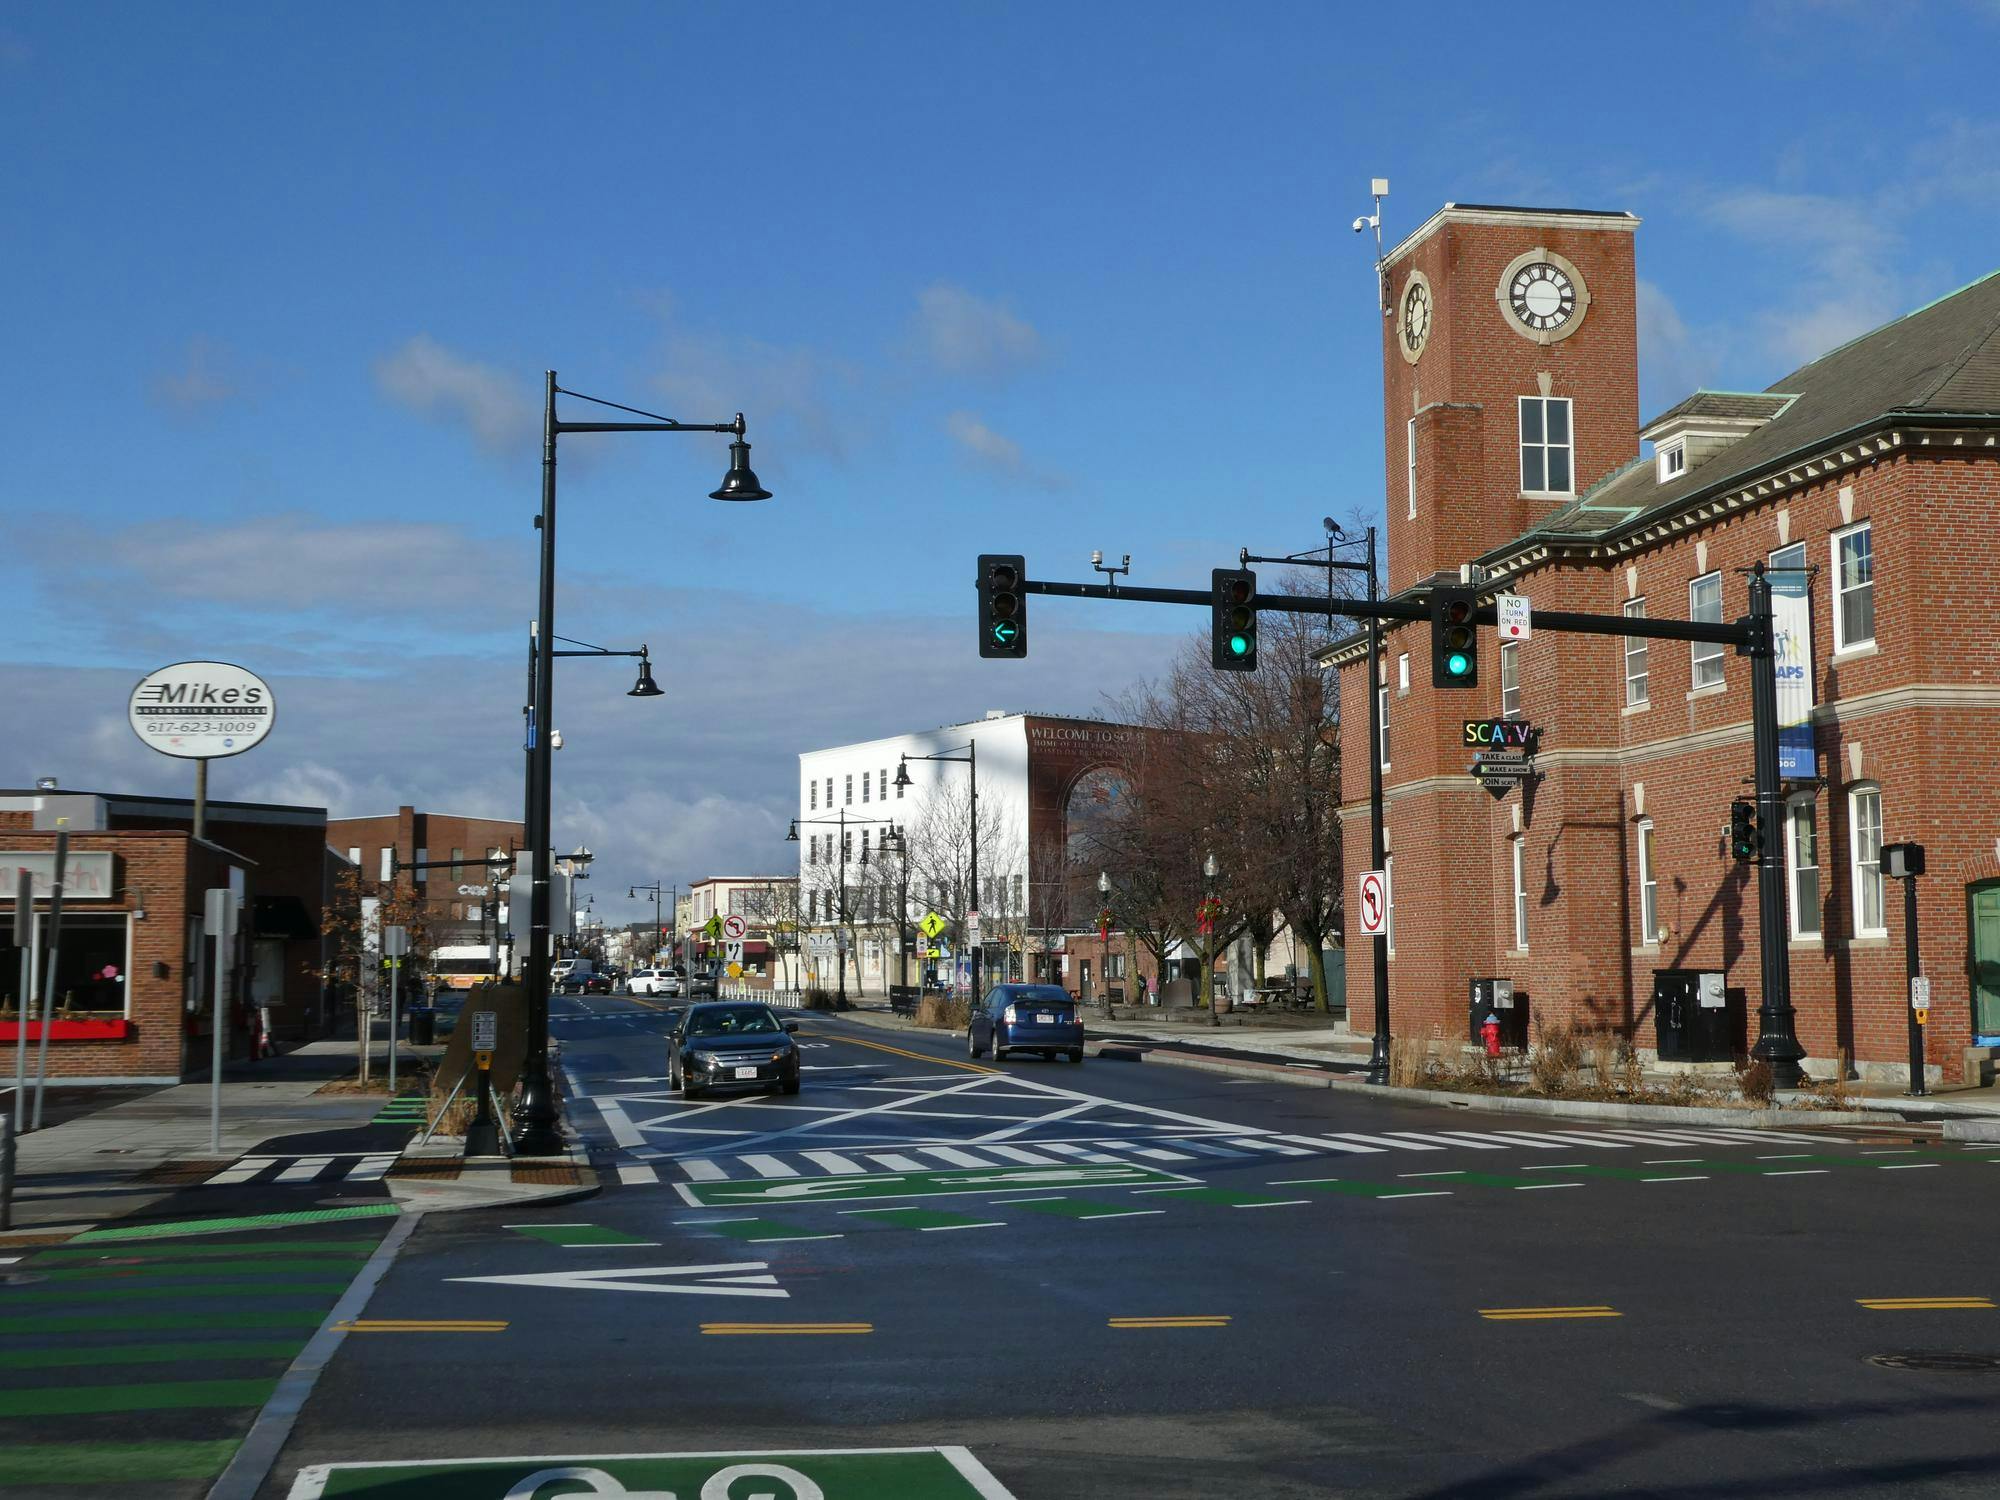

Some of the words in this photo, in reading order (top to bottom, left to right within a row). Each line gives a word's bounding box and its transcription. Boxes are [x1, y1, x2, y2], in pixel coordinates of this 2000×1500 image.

[1506, 600, 1521, 608] NO
[1776, 666, 1804, 678] APS
[158, 683, 262, 703] Mike's
[147, 722, 256, 732] 617-623-1009
